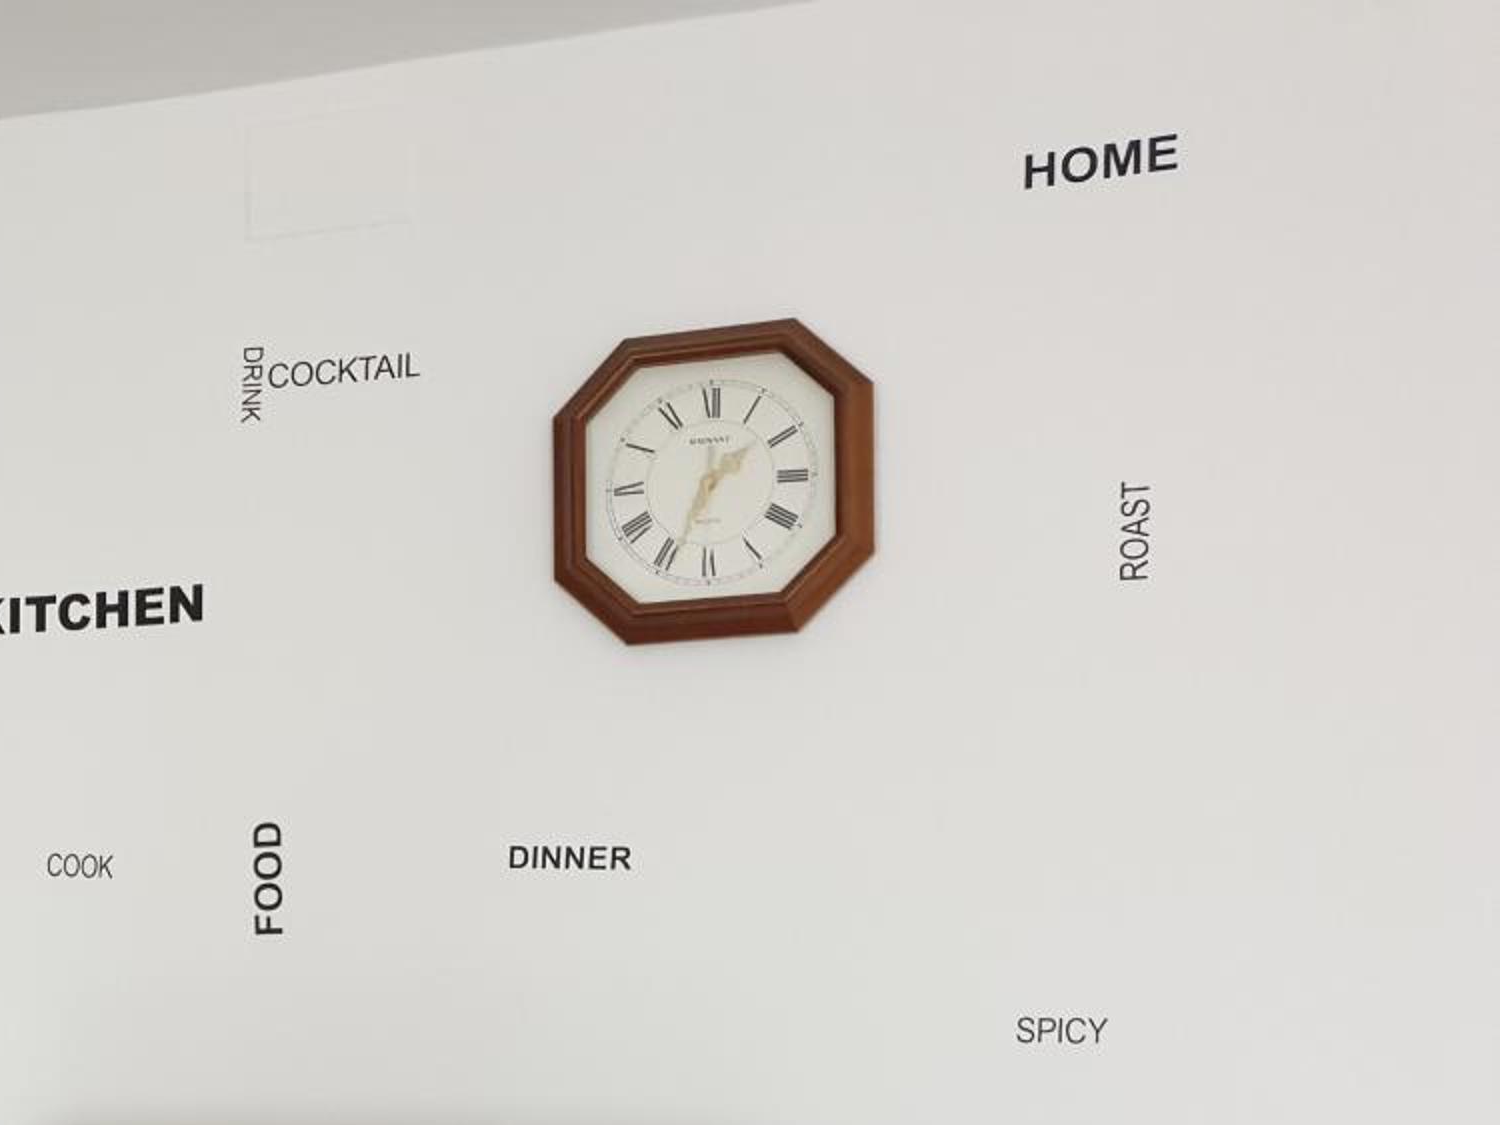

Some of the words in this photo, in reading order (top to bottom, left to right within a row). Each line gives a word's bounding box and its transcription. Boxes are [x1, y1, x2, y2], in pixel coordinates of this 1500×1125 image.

[1024, 133, 1178, 190] HOME
[240, 346, 265, 423] DRINK
[267, 352, 421, 389] COCKTAIL
[1119, 481, 1151, 581] ROAST
[47, 852, 114, 879] COOK
[252, 822, 284, 936] FOOD
[509, 845, 631, 871] DINNER
[1016, 1016, 1108, 1045] SPICY
